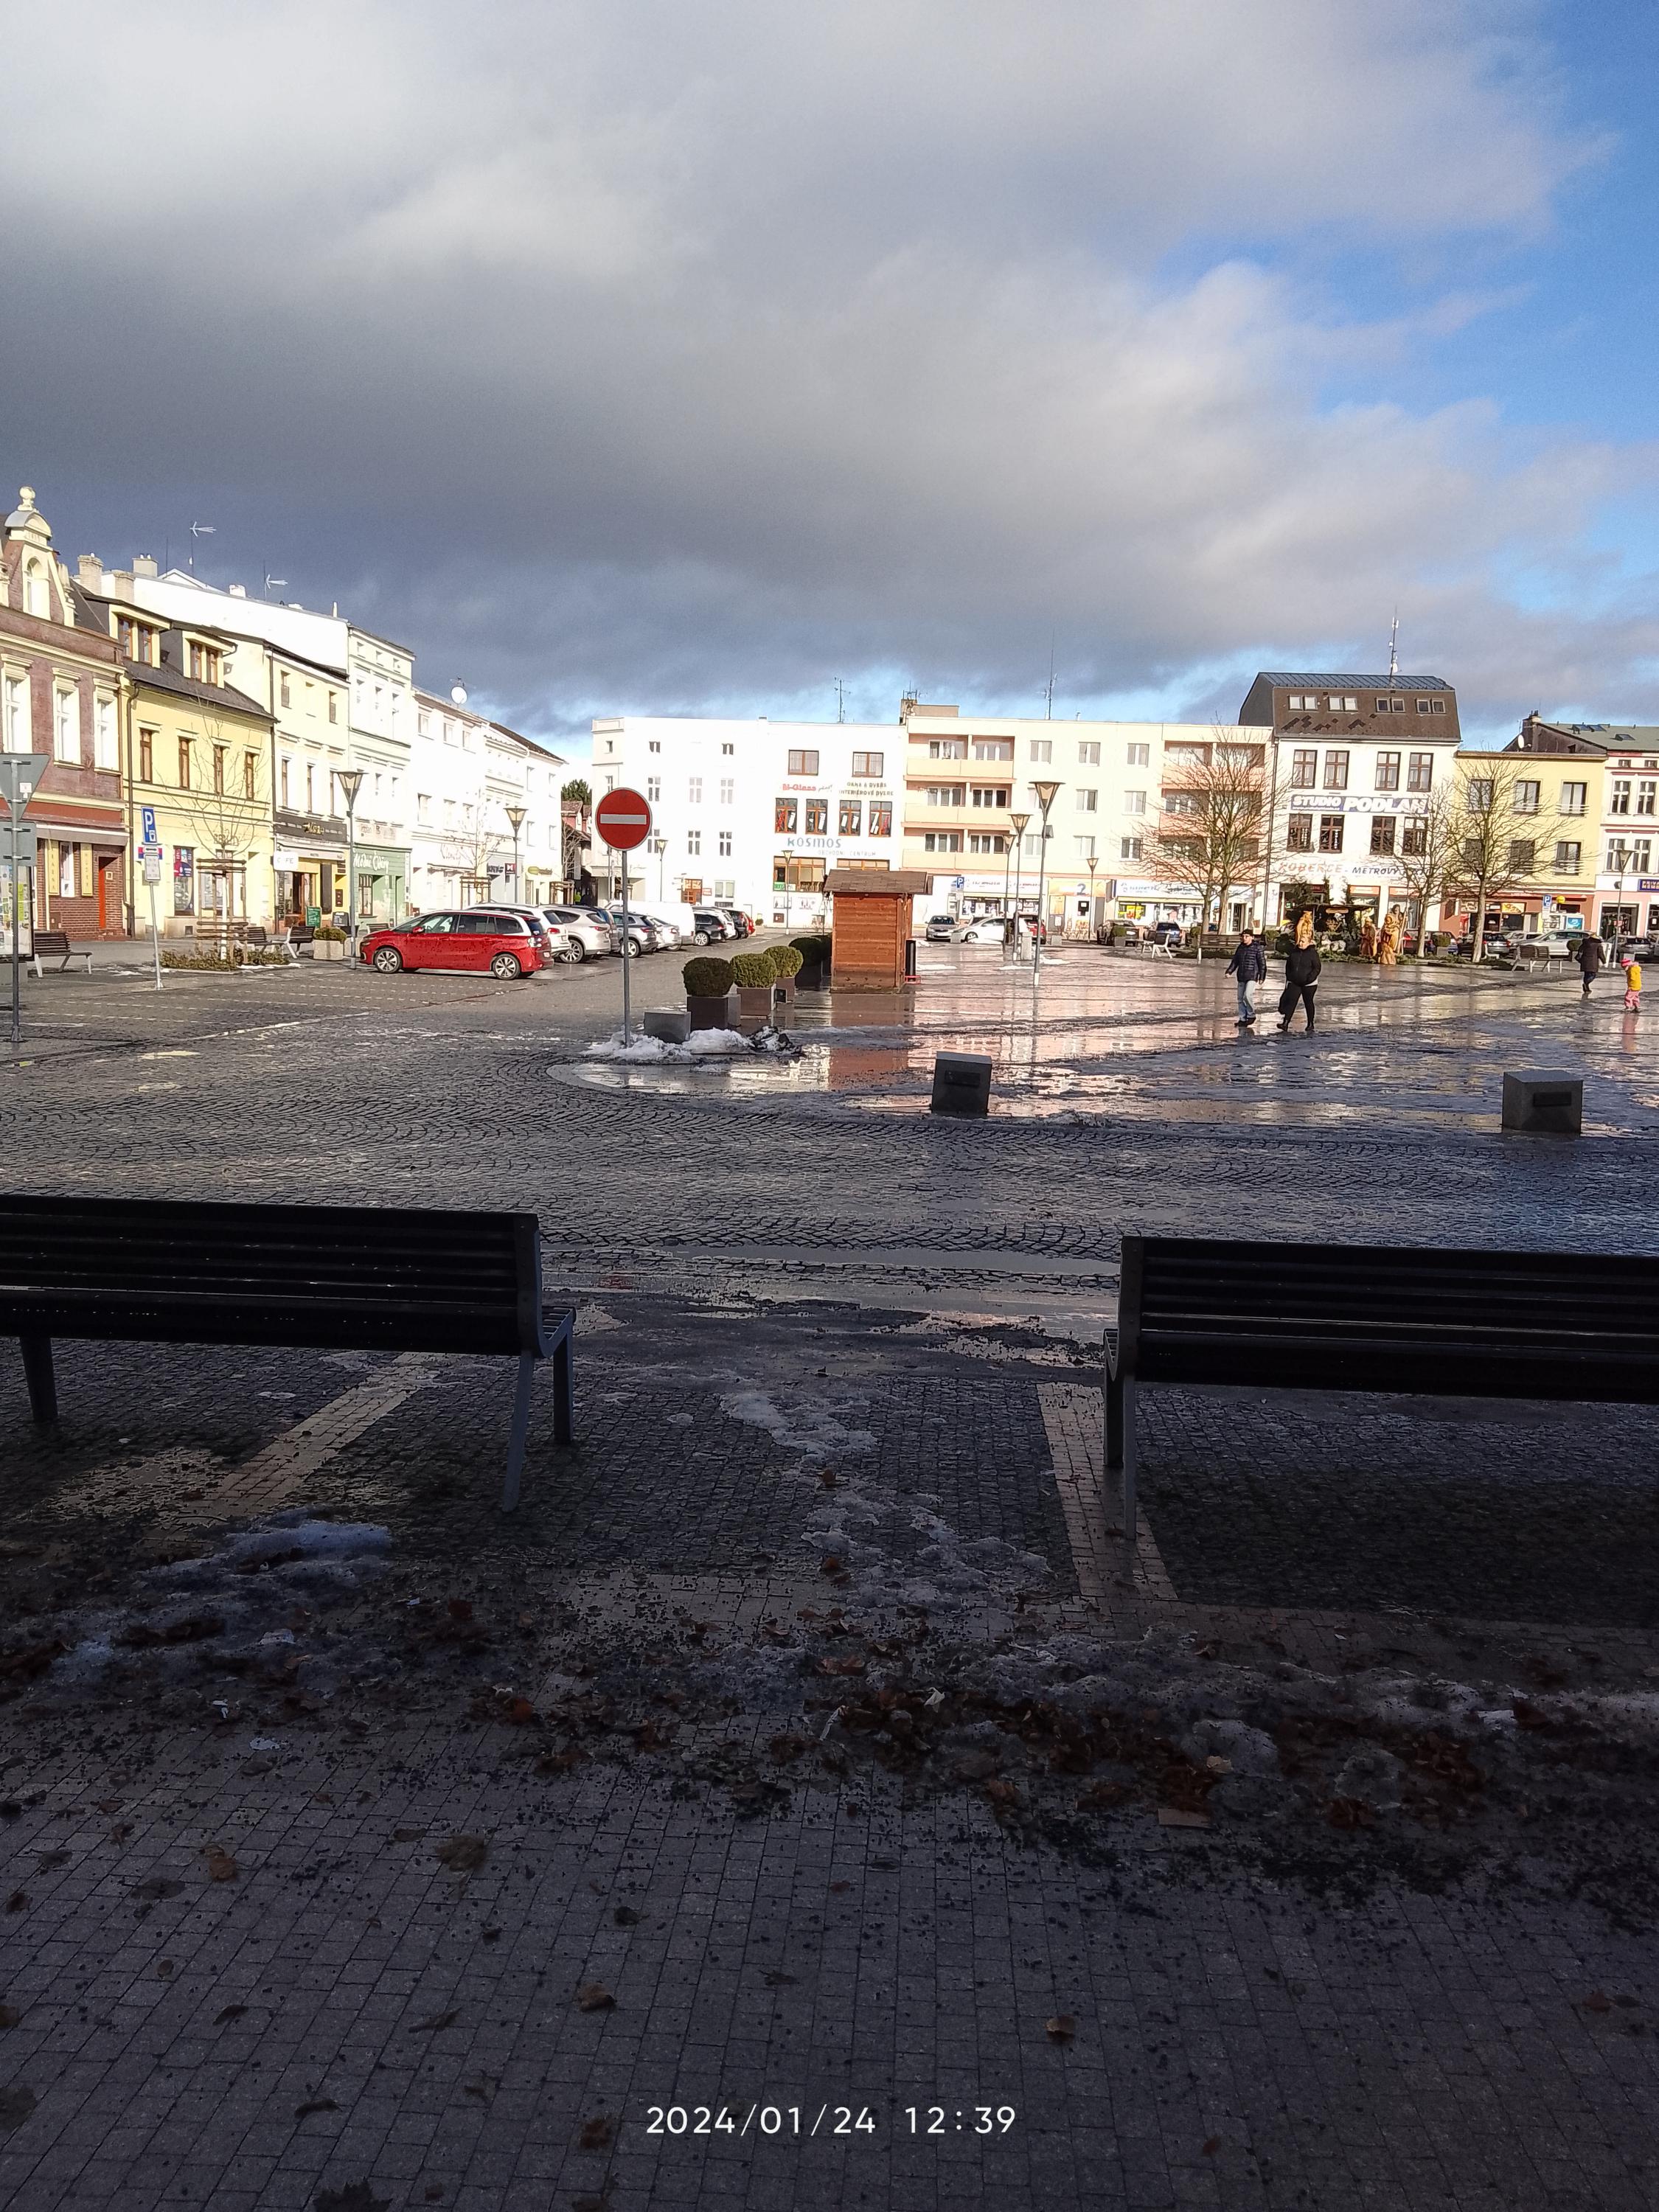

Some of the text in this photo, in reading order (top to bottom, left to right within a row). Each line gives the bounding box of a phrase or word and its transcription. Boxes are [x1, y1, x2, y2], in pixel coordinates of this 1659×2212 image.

[1293, 796, 1427, 813] STUDIO PODLAH
[145, 812, 153, 832] P
[787, 837, 842, 848] KOSMOS
[1278, 863, 1343, 874] KOBERCE
